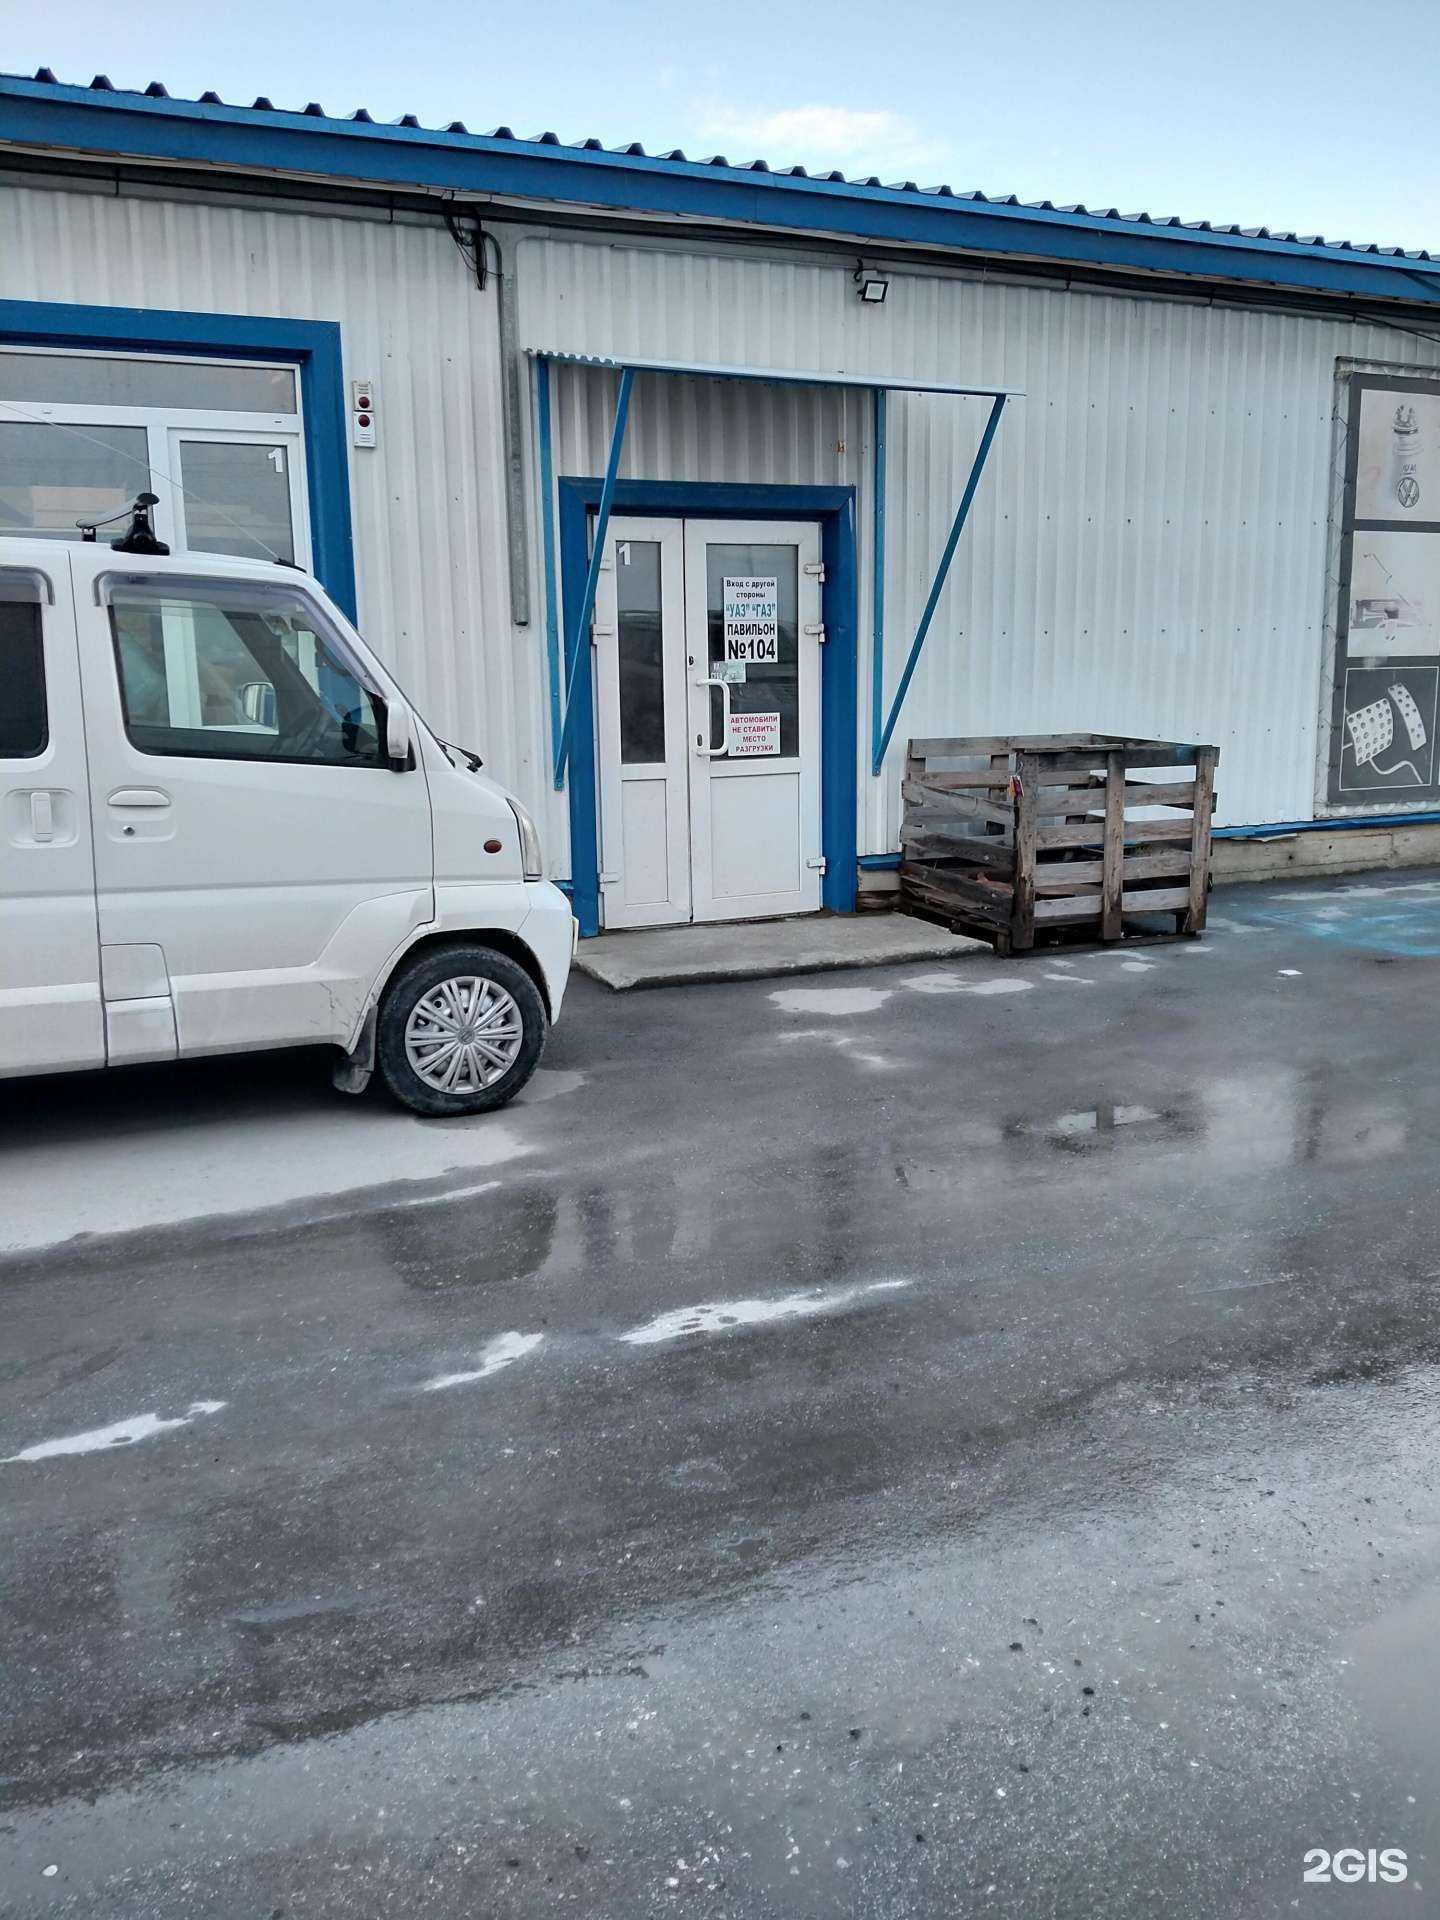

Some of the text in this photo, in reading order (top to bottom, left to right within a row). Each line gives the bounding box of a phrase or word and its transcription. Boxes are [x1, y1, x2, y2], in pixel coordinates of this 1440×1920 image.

[268, 447, 283, 473] 1
[618, 542, 631, 566] 1
[726, 579, 744, 588] Вход
[751, 579, 775, 589] другой
[736, 591, 766, 600] стороны
[727, 623, 776, 636] ПАВИЛЬОН
[728, 638, 776, 660] №104
[730, 715, 778, 724] АВТОМОБИЛИ
[742, 735, 767, 743] МЕСТО
[735, 745, 774, 753] РАЗГРУЗКИ
